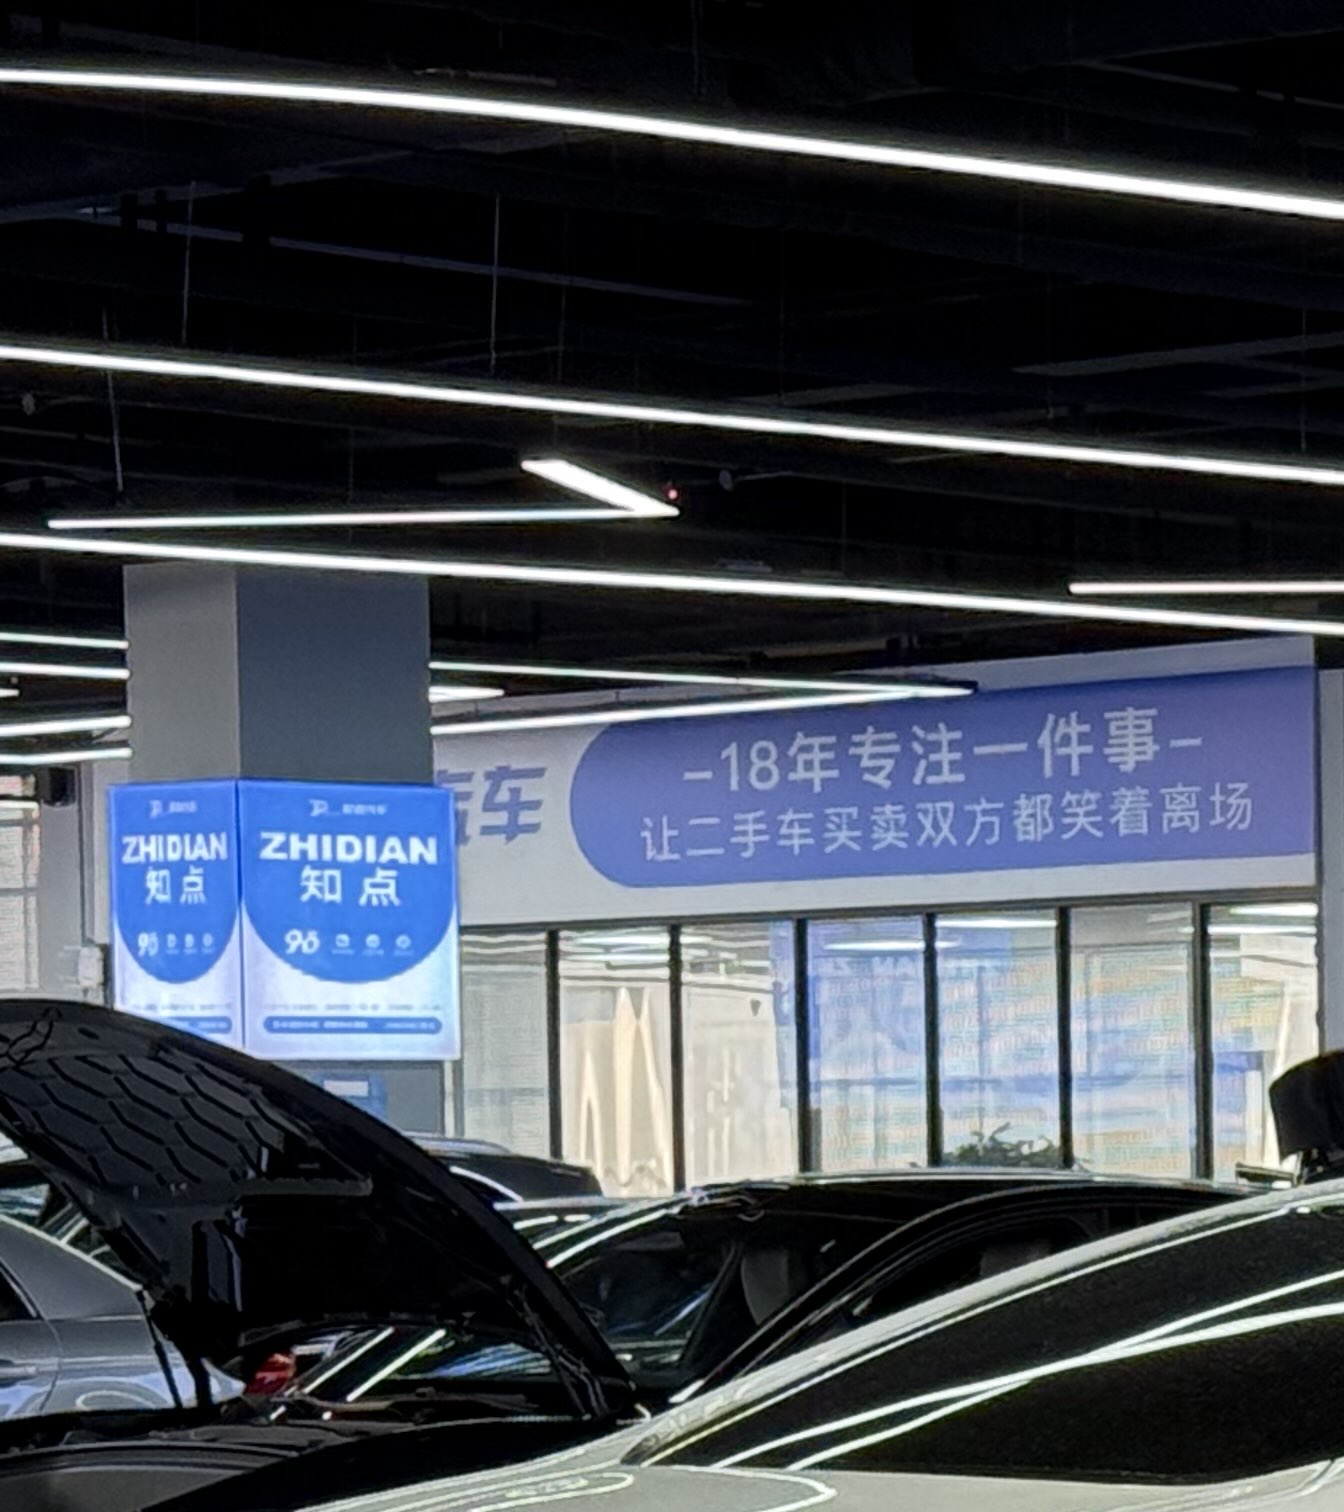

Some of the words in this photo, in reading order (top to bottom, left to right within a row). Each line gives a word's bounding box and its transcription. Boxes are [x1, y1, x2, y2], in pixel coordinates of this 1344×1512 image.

[641, 782, 1253, 864] 让二手车买卖双方都笑着离场
[122, 832, 228, 865] ZHIDIAN
[259, 831, 438, 865] ZHIDIAN
[145, 867, 206, 903] 知点
[300, 866, 400, 907] 知点
